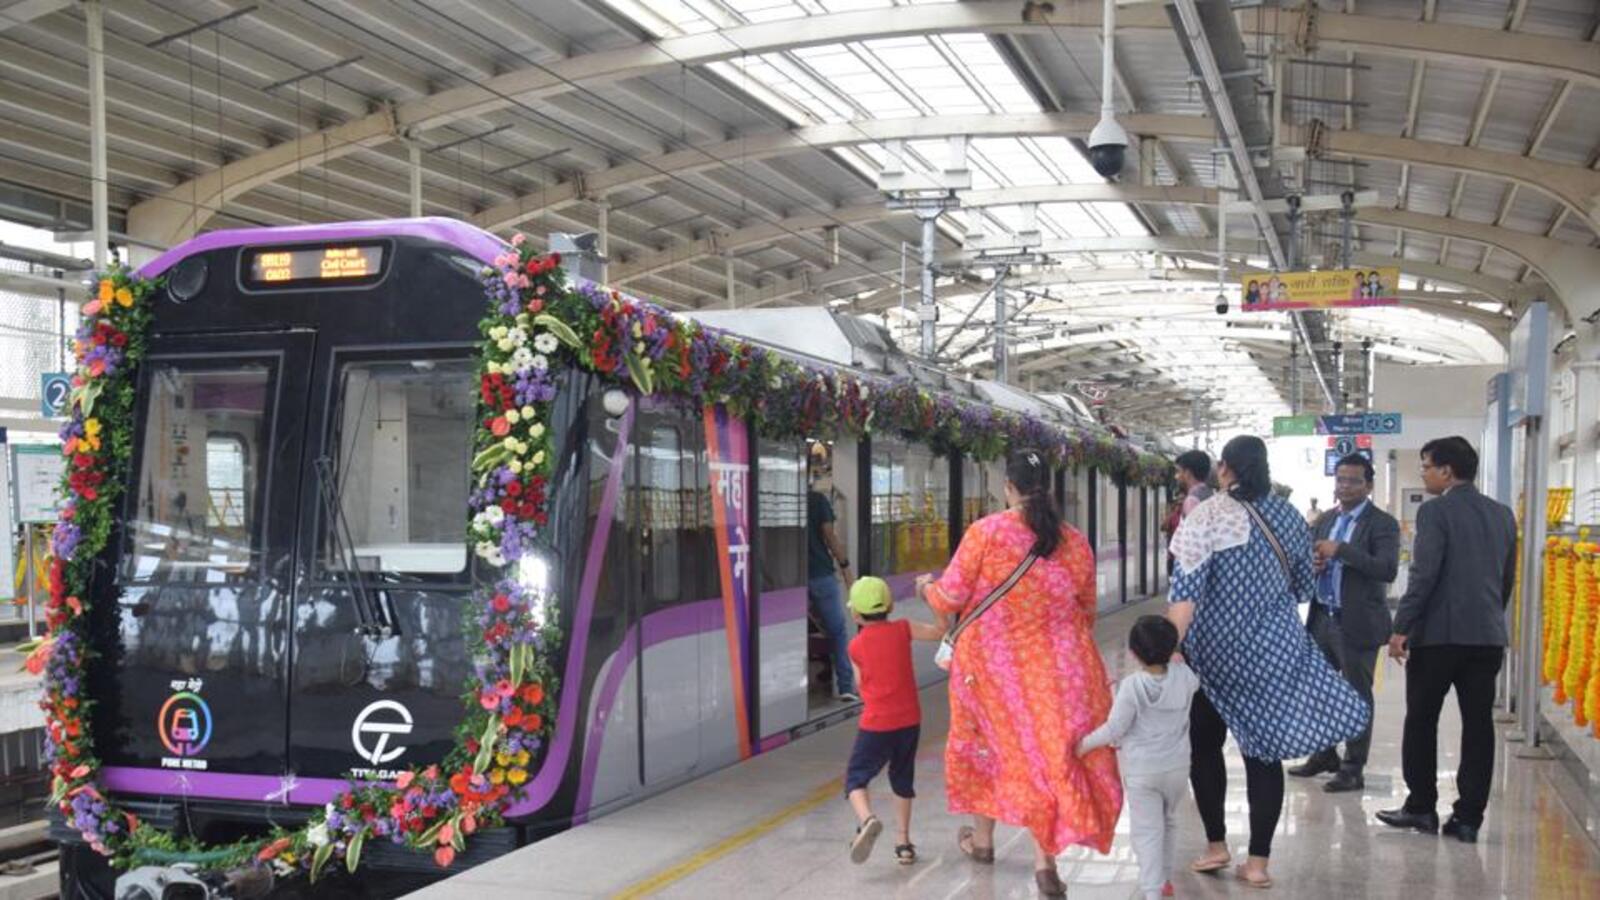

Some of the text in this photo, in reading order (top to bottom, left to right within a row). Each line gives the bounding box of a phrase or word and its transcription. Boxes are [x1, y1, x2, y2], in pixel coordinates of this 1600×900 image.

[52, 382, 66, 407] 2
[1341, 442, 1348, 454] 1
[709, 463, 749, 524] महा
[161, 758, 208, 770] PUNE METRO
